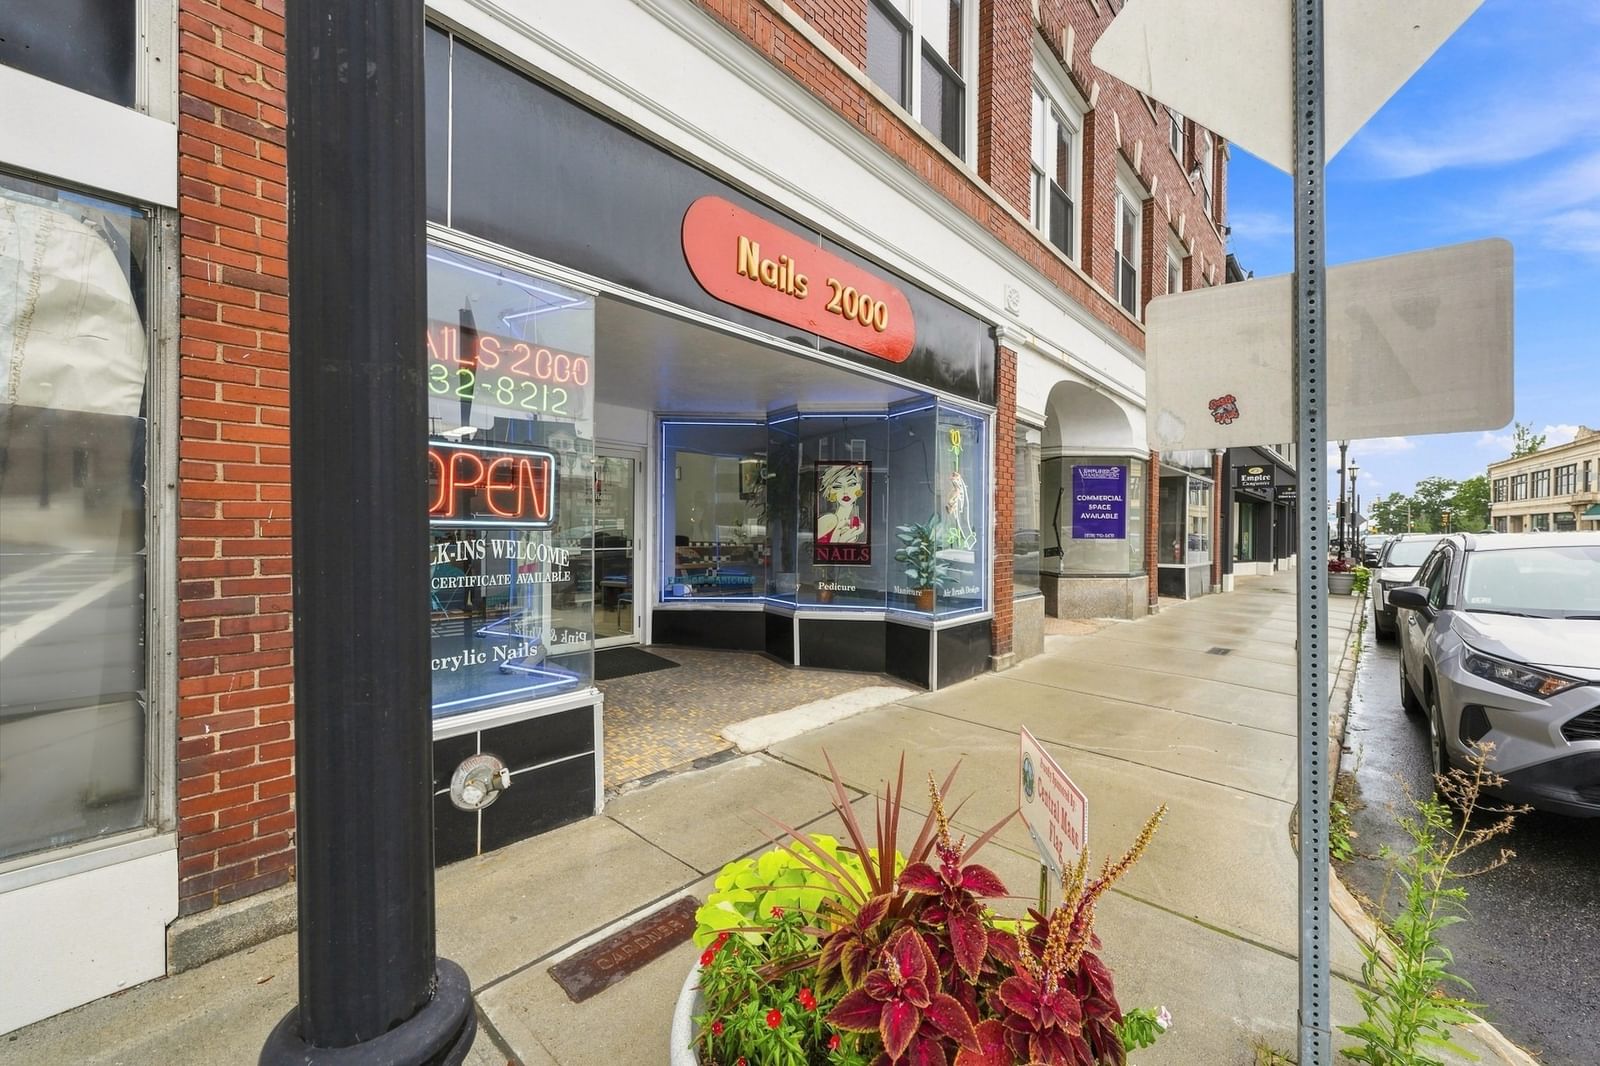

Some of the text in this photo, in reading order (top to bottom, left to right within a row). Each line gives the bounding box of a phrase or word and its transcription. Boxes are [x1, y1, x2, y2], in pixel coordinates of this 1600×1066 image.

[737, 235, 888, 332] Nails 2000
[511, 344, 589, 386] 2000
[491, 539, 570, 567] WELCOME
[817, 547, 870, 562] NAILS
[431, 571, 571, 589] CERTIFICATE AVAILABLE
[818, 581, 856, 592] Pedicure
[894, 585, 922, 597] Manicure
[492, 642, 538, 662] Nails
[1037, 777, 1060, 825] Central
